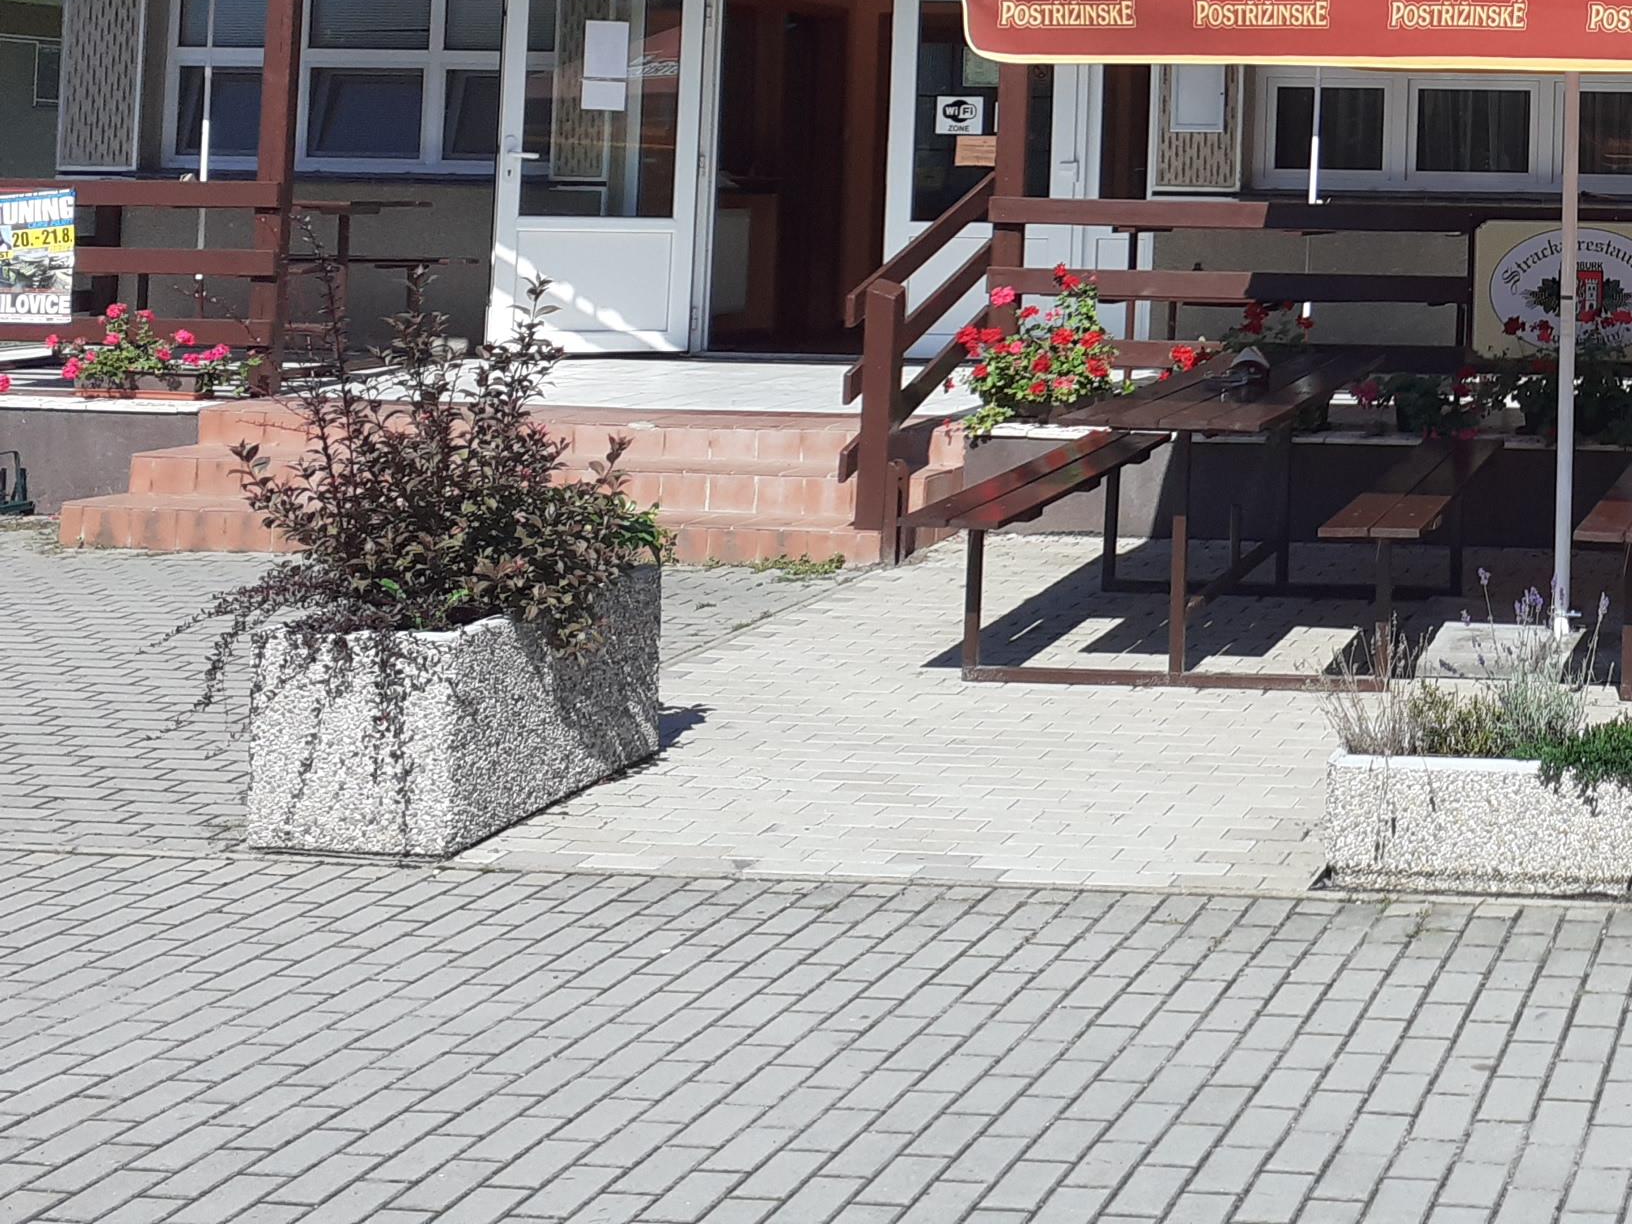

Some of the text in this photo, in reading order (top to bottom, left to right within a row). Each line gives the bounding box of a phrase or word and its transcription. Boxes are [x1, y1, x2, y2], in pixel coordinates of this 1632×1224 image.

[0, 196, 74, 225] UNING
[1502, 239, 1562, 296] Strack
[0, 293, 71, 314] ILOVICE
